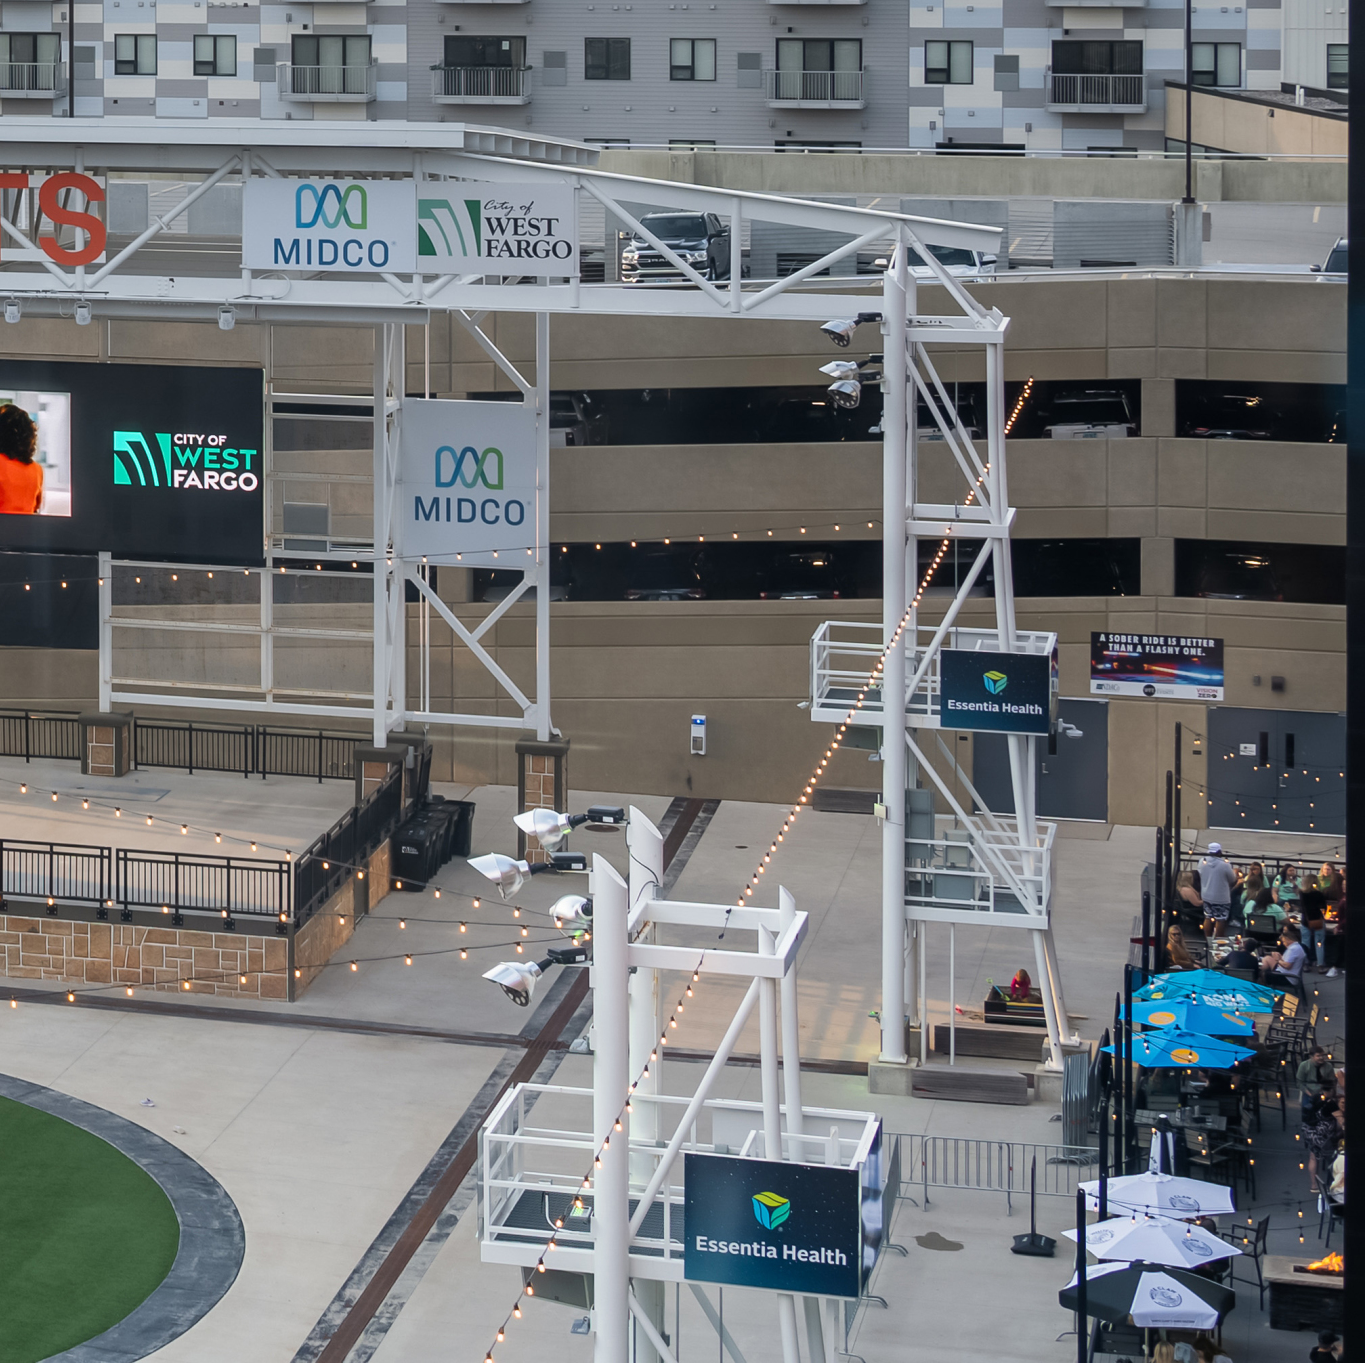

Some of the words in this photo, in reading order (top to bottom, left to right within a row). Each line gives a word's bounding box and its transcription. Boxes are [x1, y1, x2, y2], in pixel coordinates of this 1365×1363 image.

[483, 199, 516, 216] City
[520, 200, 535, 215] of
[484, 217, 560, 237] WEST
[273, 238, 389, 267] MIDCO
[484, 239, 573, 260] FARGO
[173, 434, 205, 445] CITY
[207, 435, 227, 446] OF
[173, 446, 257, 470] WEST
[173, 469, 259, 492] FARGO
[415, 496, 525, 526] MIDCO
[1099, 634, 1106, 642] A
[1109, 634, 1139, 643] SOBER
[1142, 636, 1165, 645] RIDE
[1180, 639, 1215, 648] BETTER
[1109, 643, 1133, 652] THAN
[1136, 645, 1143, 653] A
[1145, 646, 1180, 655] FLASHY
[1183, 647, 1206, 656] ONE.
[947, 699, 999, 713] Essentia
[1002, 702, 1043, 715] Health
[696, 1235, 777, 1259] Essentia
[783, 1244, 847, 1266] Health
